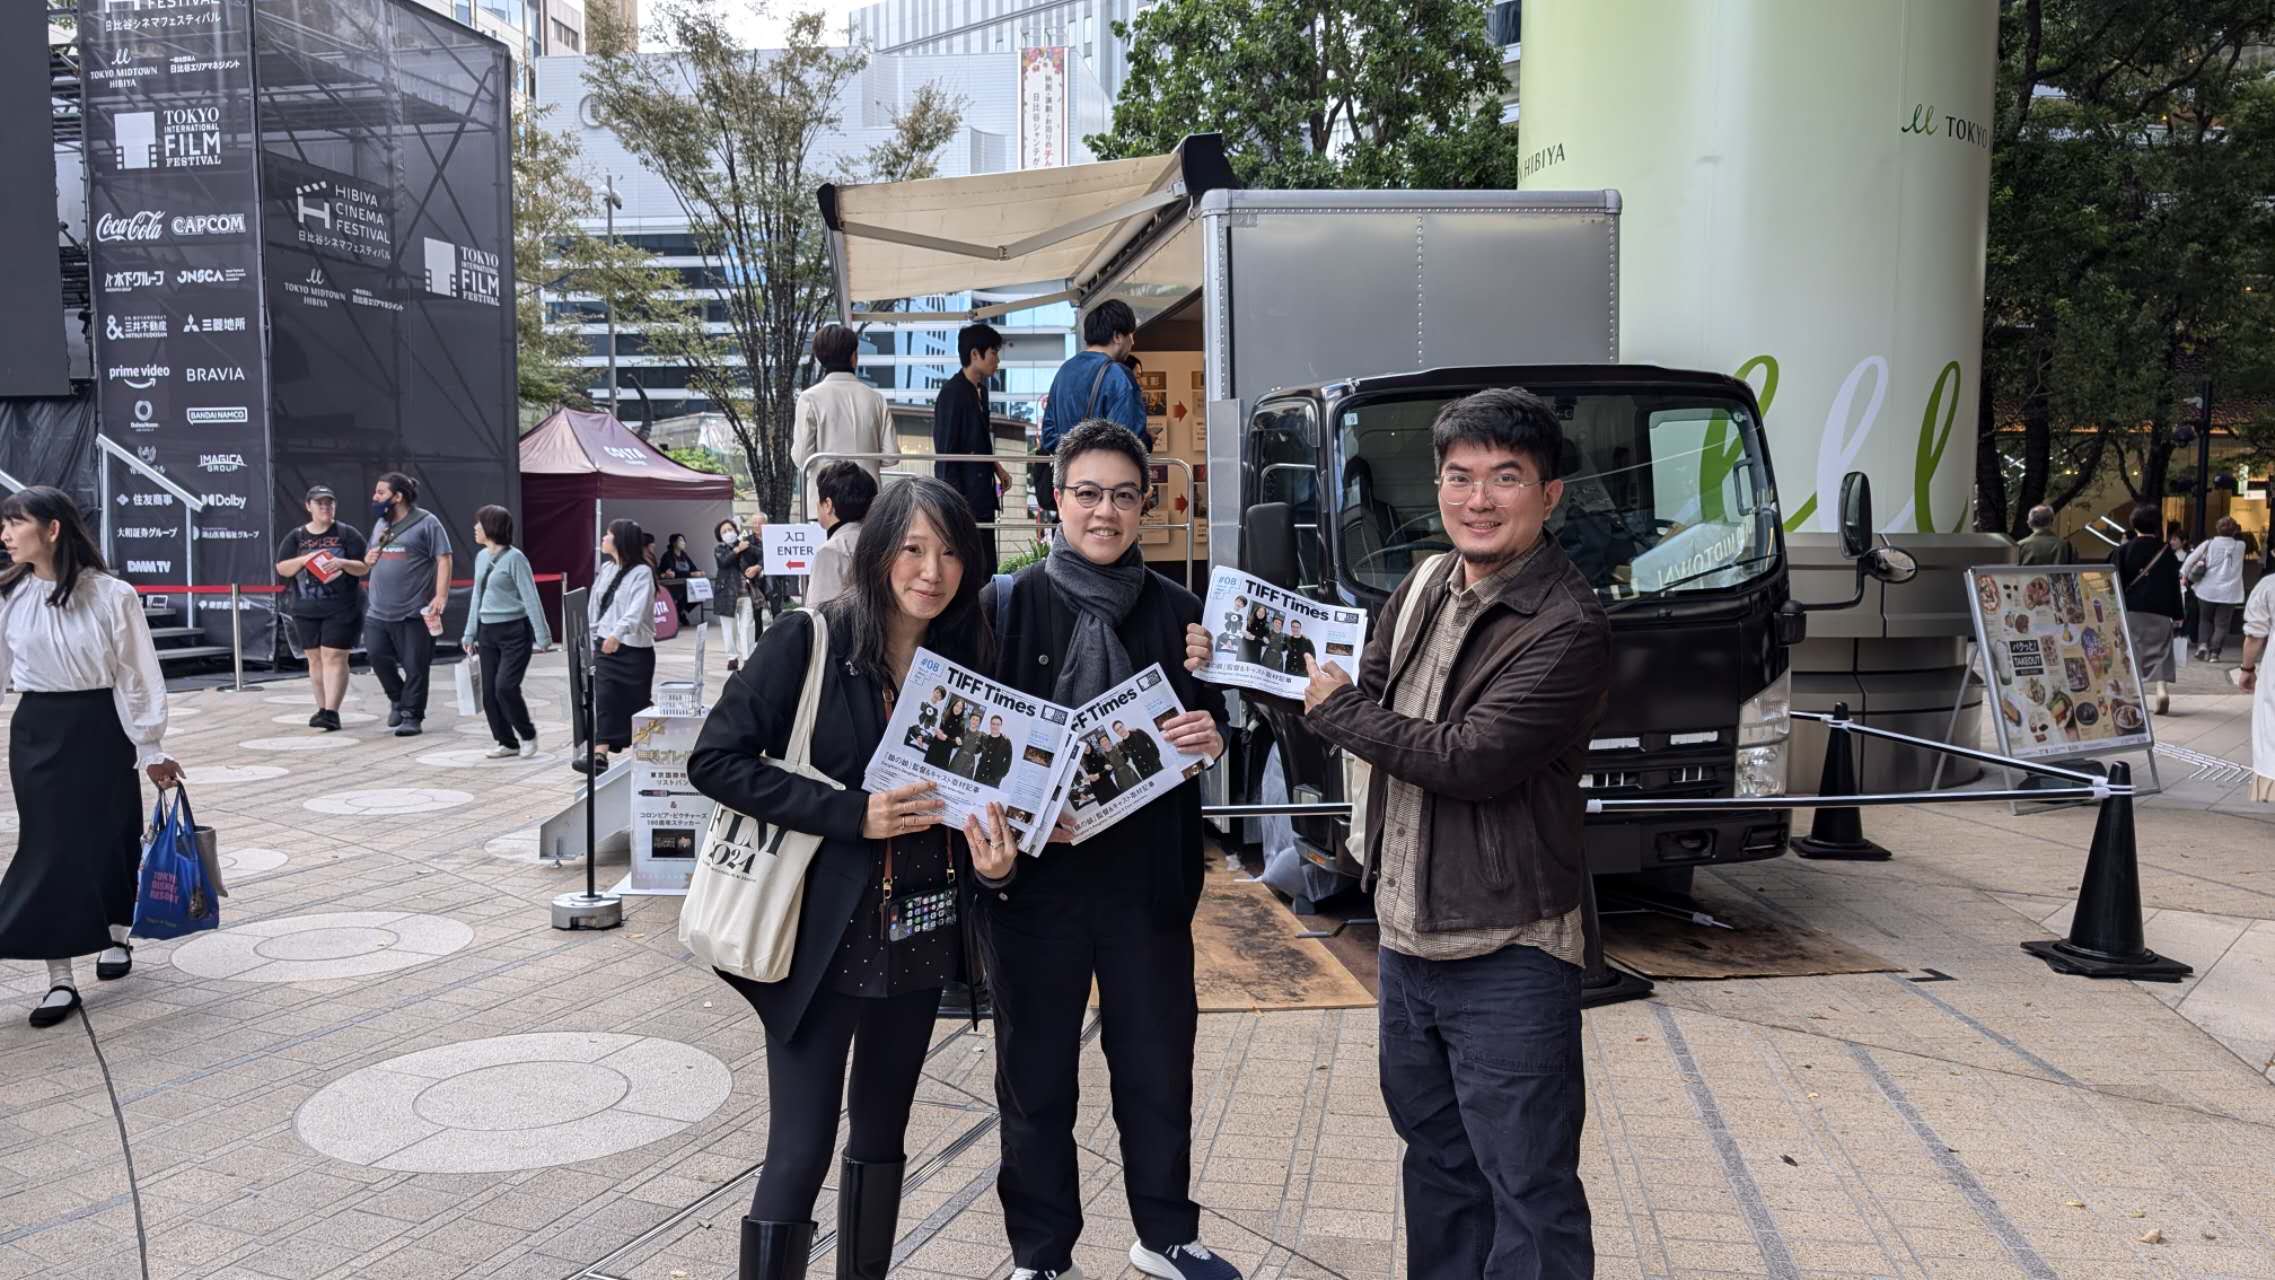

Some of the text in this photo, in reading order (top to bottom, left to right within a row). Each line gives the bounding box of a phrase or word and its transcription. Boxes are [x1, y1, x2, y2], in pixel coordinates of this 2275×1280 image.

[148, 0, 220, 9] FEST
[105, 12, 221, 32] 日比谷シネマフェスティバル
[90, 66, 158, 79] TOKYO MIDTOWN
[109, 79, 137, 88] HIBIYA
[163, 107, 220, 125] TOKYO
[164, 123, 219, 133] INTERNATIONAL
[1945, 115, 1988, 149] TOKYO
[164, 132, 221, 156] FILM
[165, 155, 221, 168] FESTIVAL
[1524, 142, 1566, 179] HIBIYA
[335, 184, 378, 207] HIBIYA
[335, 202, 385, 226] CINEMA
[172, 213, 246, 235] CAPCOM
[336, 219, 390, 245] FESTIVAL
[298, 230, 391, 260] 日比谷シネマフェスティバル
[460, 246, 499, 267] TOKYO
[461, 269, 500, 297] FILM
[284, 282, 346, 301] TOKYO MIDTOWN
[463, 291, 500, 307] FESTIVAL
[303, 296, 328, 308] HIBIYA
[202, 317, 245, 332] 三菱地所
[109, 364, 170, 380] prime video
[187, 367, 245, 382] BRAVIA
[191, 411, 244, 420] BANDAI NAMCO
[199, 454, 244, 465] IMAGICA
[207, 464, 238, 473] GROUP
[133, 494, 173, 506] 住友商事
[216, 494, 246, 509] Dolby
[117, 527, 178, 538] 大和証券グループ
[784, 531, 805, 542] 入口
[777, 545, 814, 556] ENTER
[127, 560, 171, 573] DMM TV
[1218, 576, 1237, 586] #08
[1245, 579, 1281, 604] TIFF
[1281, 594, 1329, 621] Times
[921, 658, 940, 672] #08
[948, 666, 983, 695] TIFF
[984, 683, 1036, 717] Times
[1087, 688, 1138, 722] Times
[709, 841, 756, 874] 024
